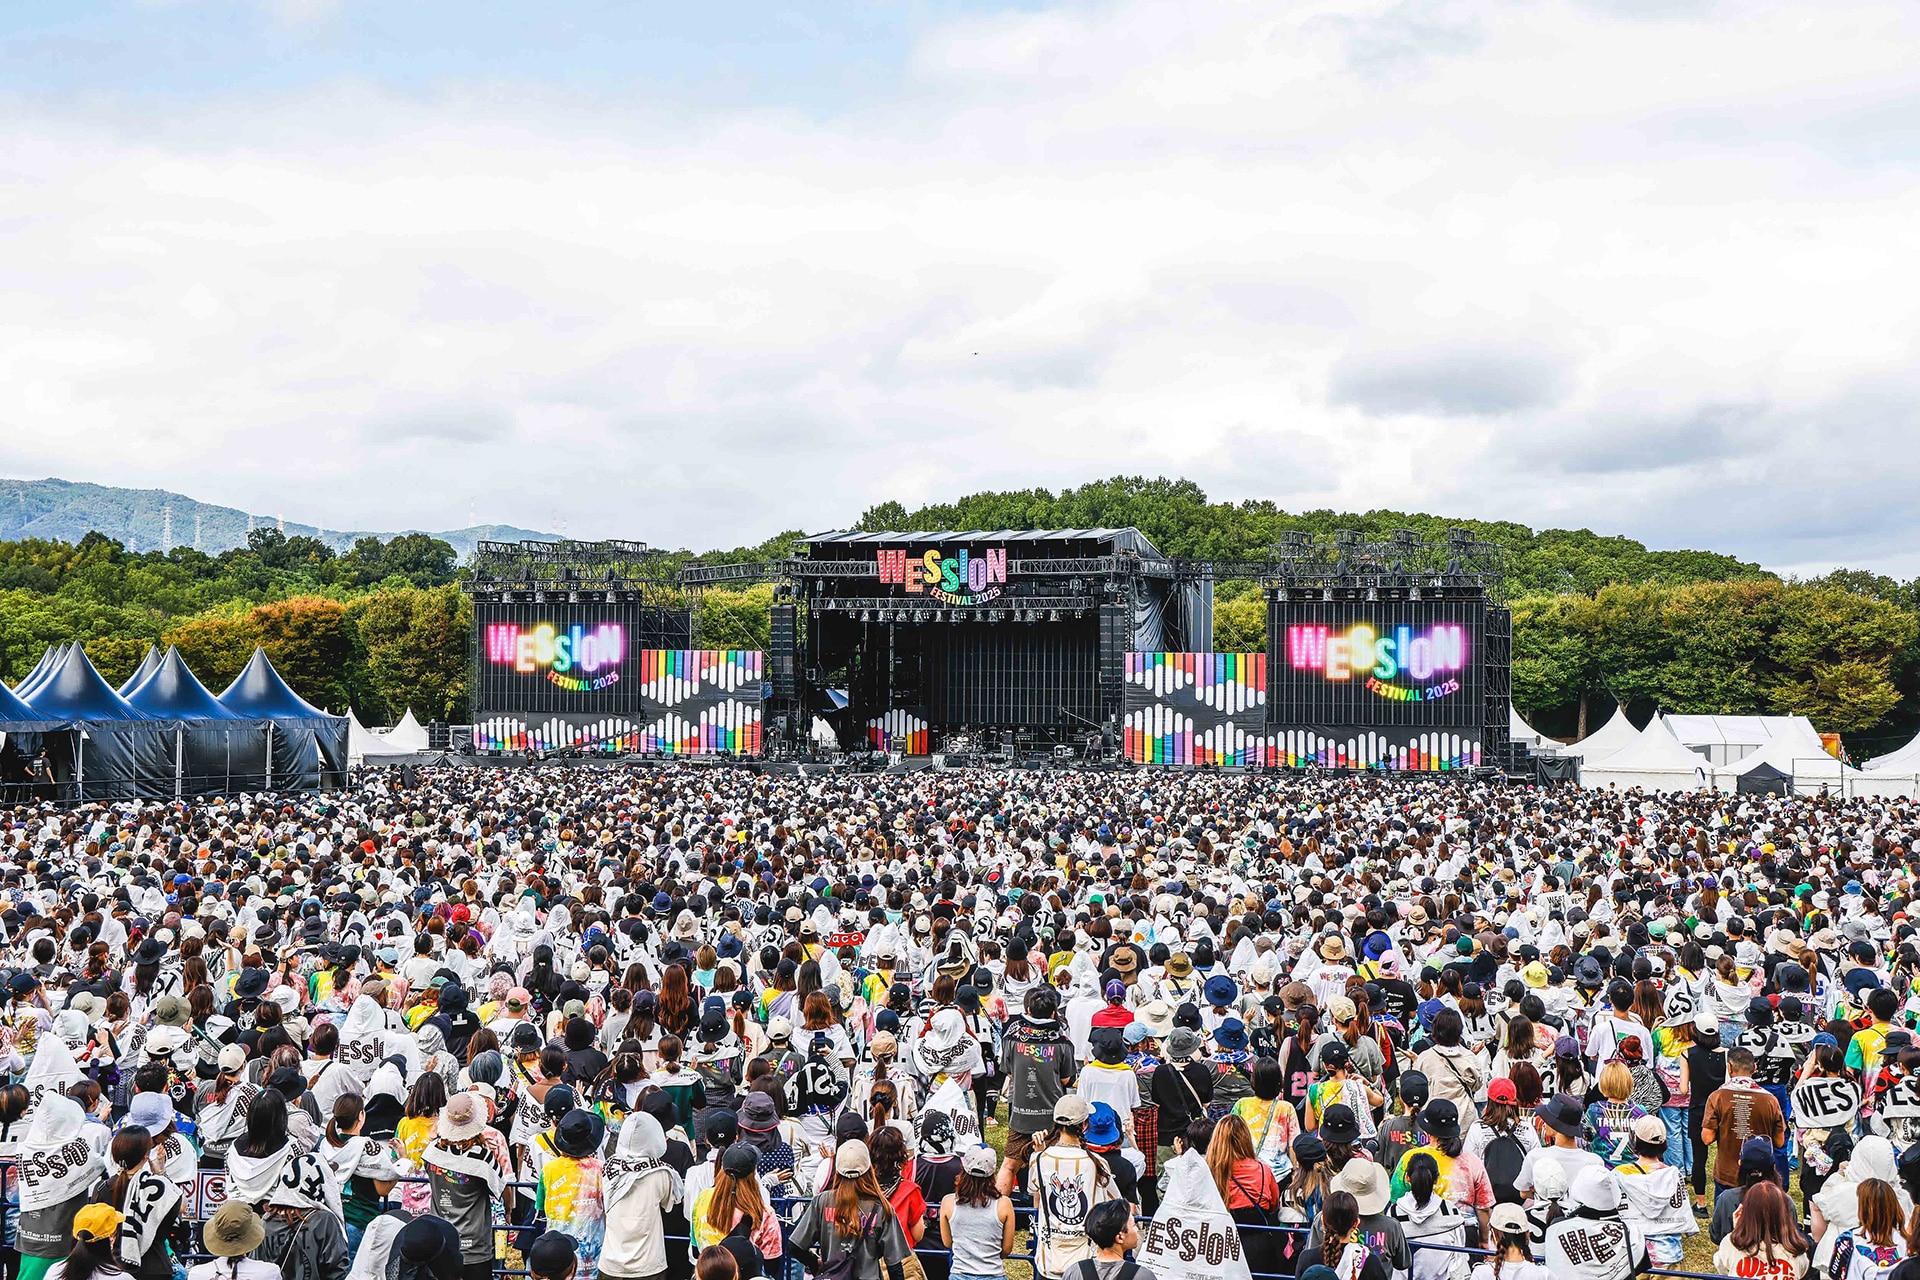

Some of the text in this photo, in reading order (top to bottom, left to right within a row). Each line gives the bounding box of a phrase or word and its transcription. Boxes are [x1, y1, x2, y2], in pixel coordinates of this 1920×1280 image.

[877, 548, 1006, 592] WESSION
[930, 586, 1001, 605] FESTIVAL 2025
[488, 625, 621, 672] WESSION
[1289, 627, 1461, 679] WESSION
[547, 670, 619, 691] FESTIVAL 2025
[1366, 677, 1460, 701] FESTIVAL 2025
[1320, 972, 1348, 981] WESSION
[1017, 1043, 1055, 1058] WESSION
[1796, 1082, 1860, 1118] WES
[1609, 1131, 1630, 1161] 7
